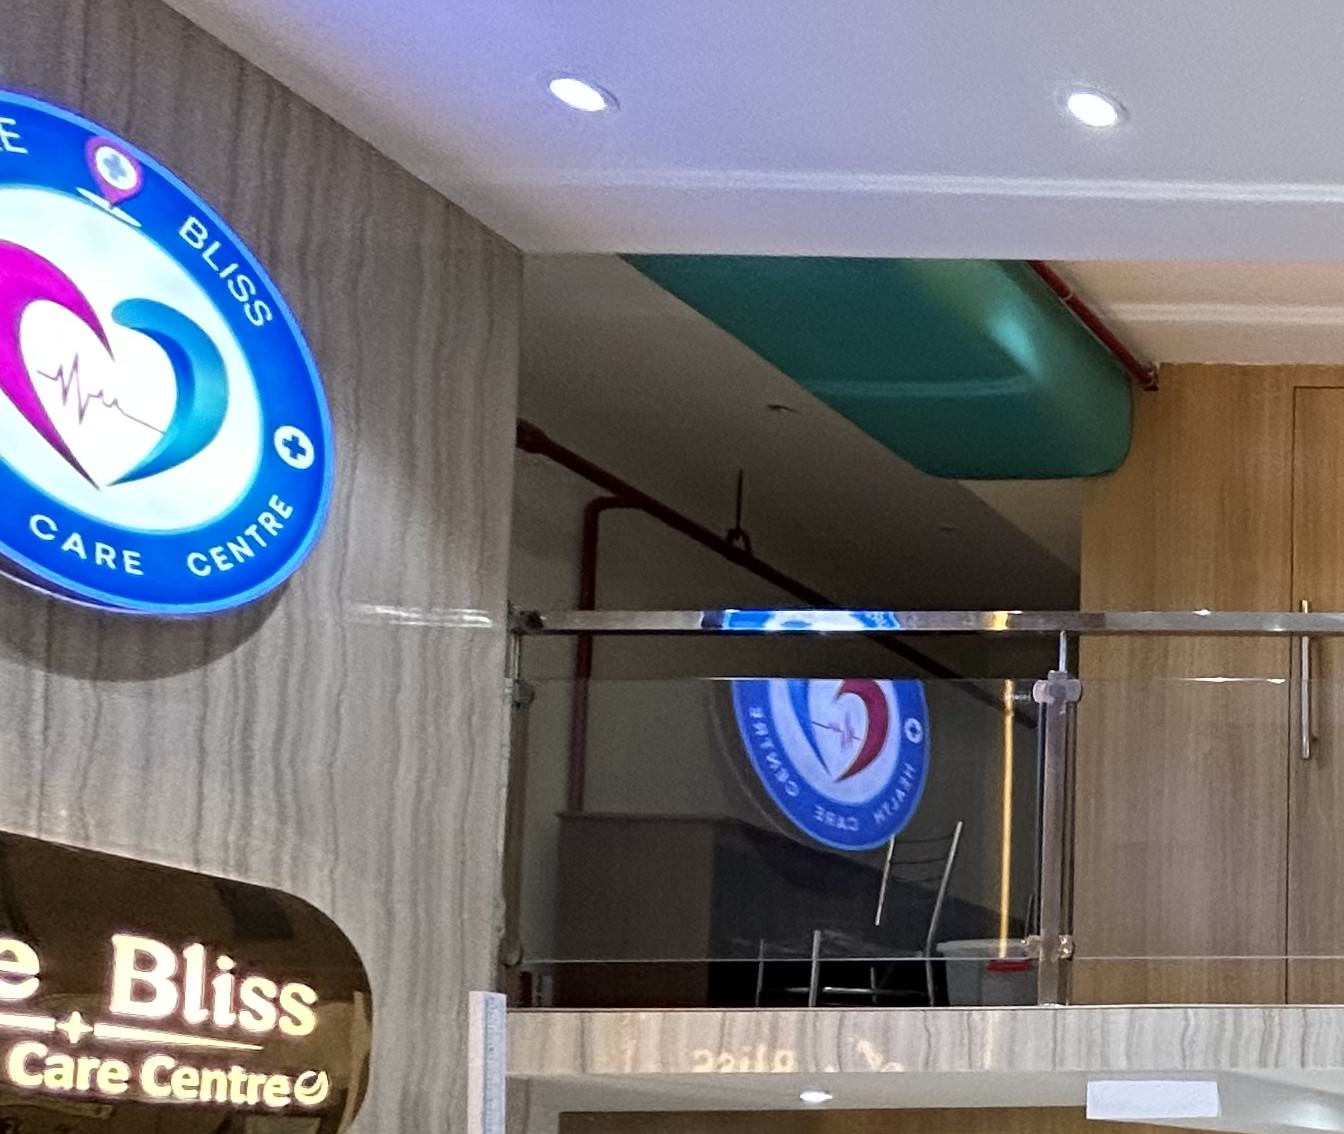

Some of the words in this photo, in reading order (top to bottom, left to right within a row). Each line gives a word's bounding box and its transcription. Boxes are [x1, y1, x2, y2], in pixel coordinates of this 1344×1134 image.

[178, 216, 273, 327] BLISS
[28, 513, 144, 576] CARE
[186, 494, 293, 577] CENTRE
[108, 933, 320, 1037] Bliss
[7, 1040, 131, 1095] Care
[139, 1054, 292, 1108] Centre
